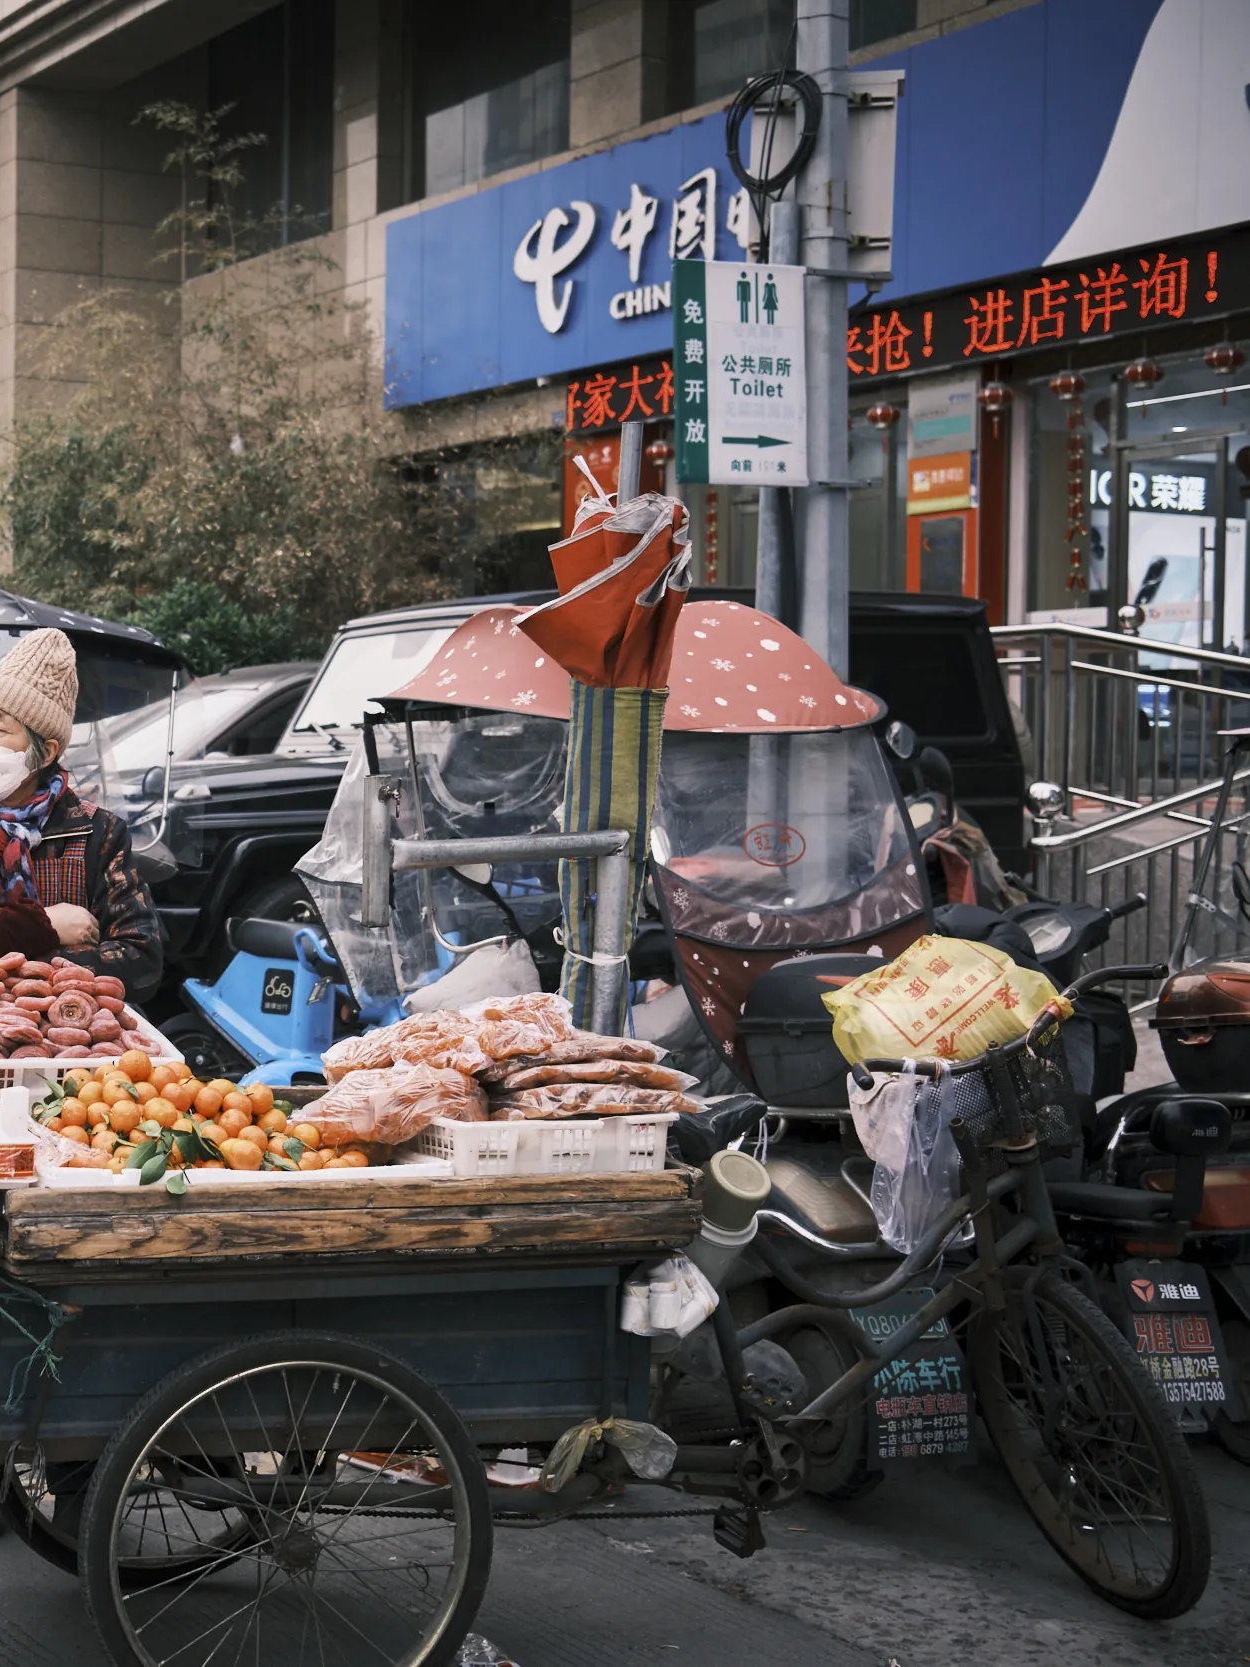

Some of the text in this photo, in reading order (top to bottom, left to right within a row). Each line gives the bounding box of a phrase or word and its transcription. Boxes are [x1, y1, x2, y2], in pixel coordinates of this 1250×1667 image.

[609, 281, 671, 320] CHIN
[683, 299, 706, 443] 免费开放
[722, 355, 791, 377] 公共厕所
[730, 378, 784, 398] Toilet
[1152, 474, 1206, 511] 荣耀
[904, 955, 954, 1000] 惠康
[955, 999, 996, 1035] WELLCOME
[1158, 1284, 1201, 1299] 雅迪
[1133, 1314, 1214, 1353] 雅迪
[876, 1392, 968, 1418] 电瓶车直销店
[1162, 1381, 1225, 1402] 13575427588
[920, 1443, 944, 1456] 6879
